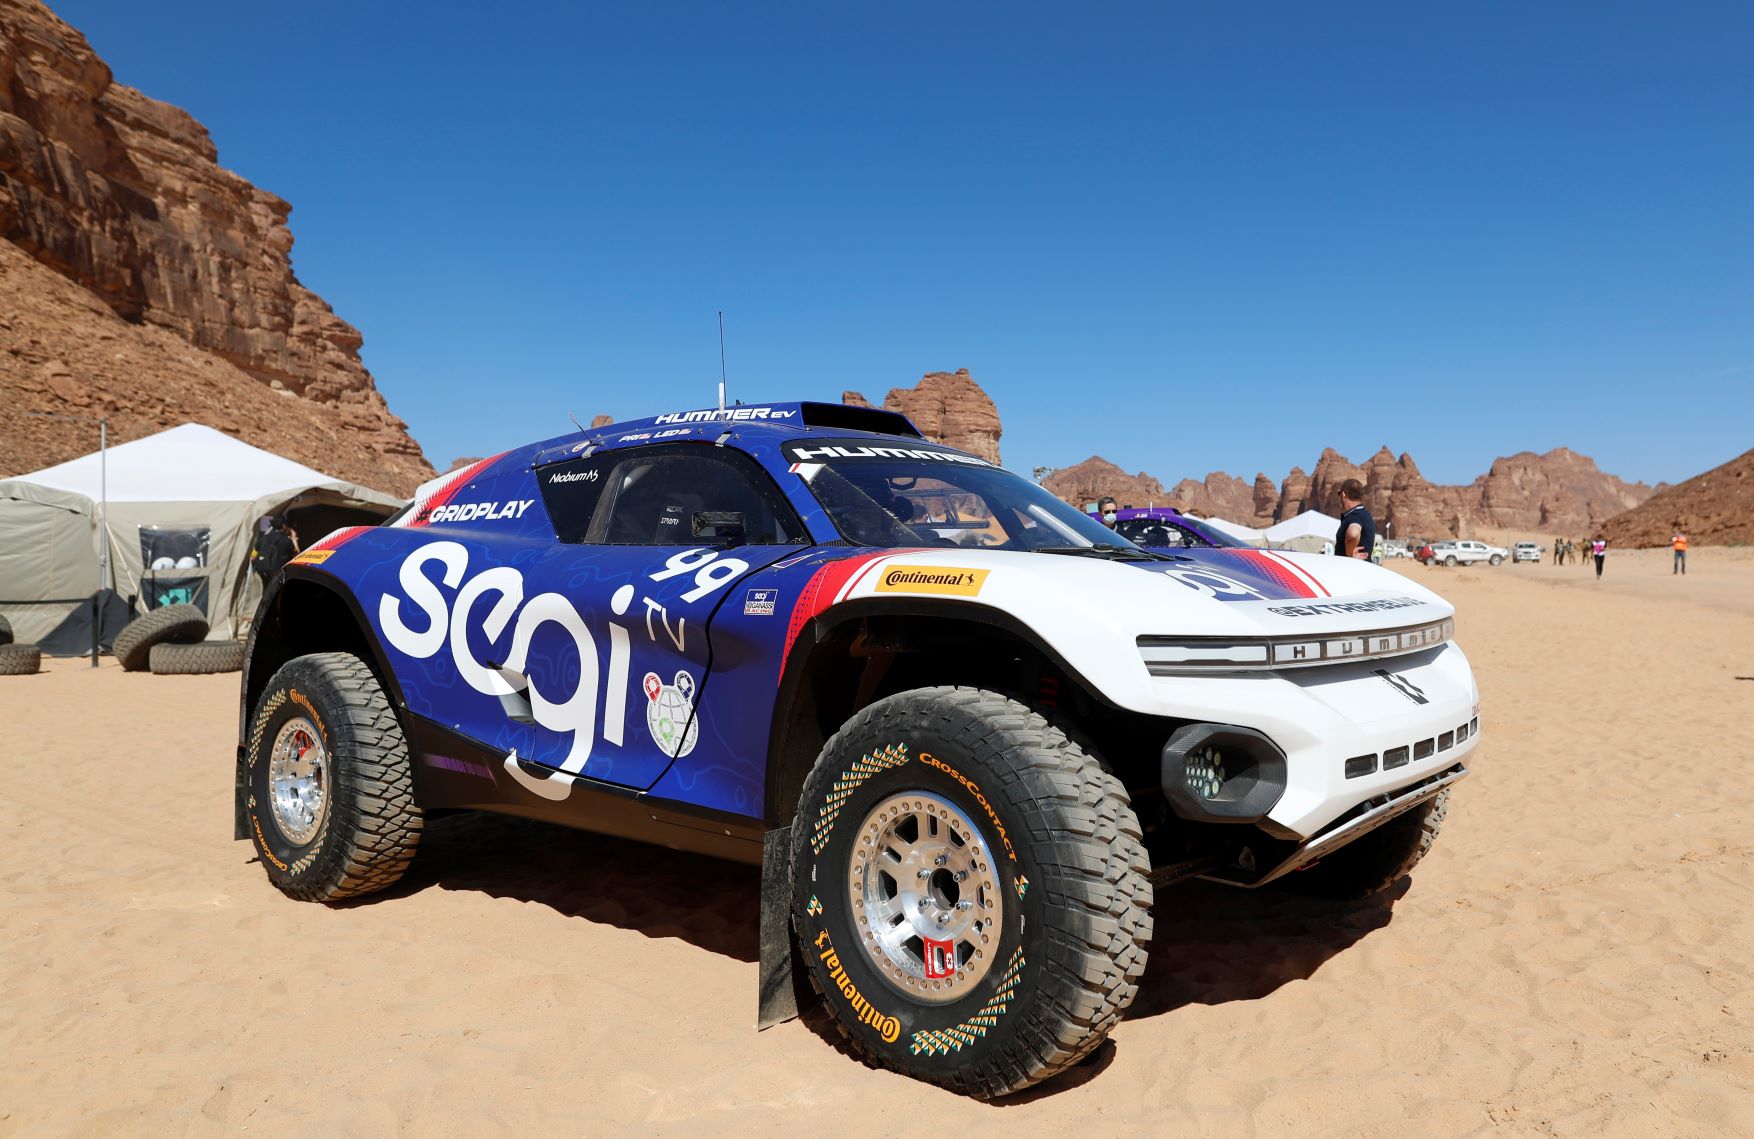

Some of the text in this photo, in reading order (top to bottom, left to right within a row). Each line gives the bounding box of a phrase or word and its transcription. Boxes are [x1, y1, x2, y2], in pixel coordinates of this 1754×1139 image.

[655, 407, 797, 425] HUMMER EV
[648, 547, 750, 604] 99
[885, 570, 964, 587] Continental
[642, 596, 686, 652] TV
[819, 946, 901, 1044] Continental
